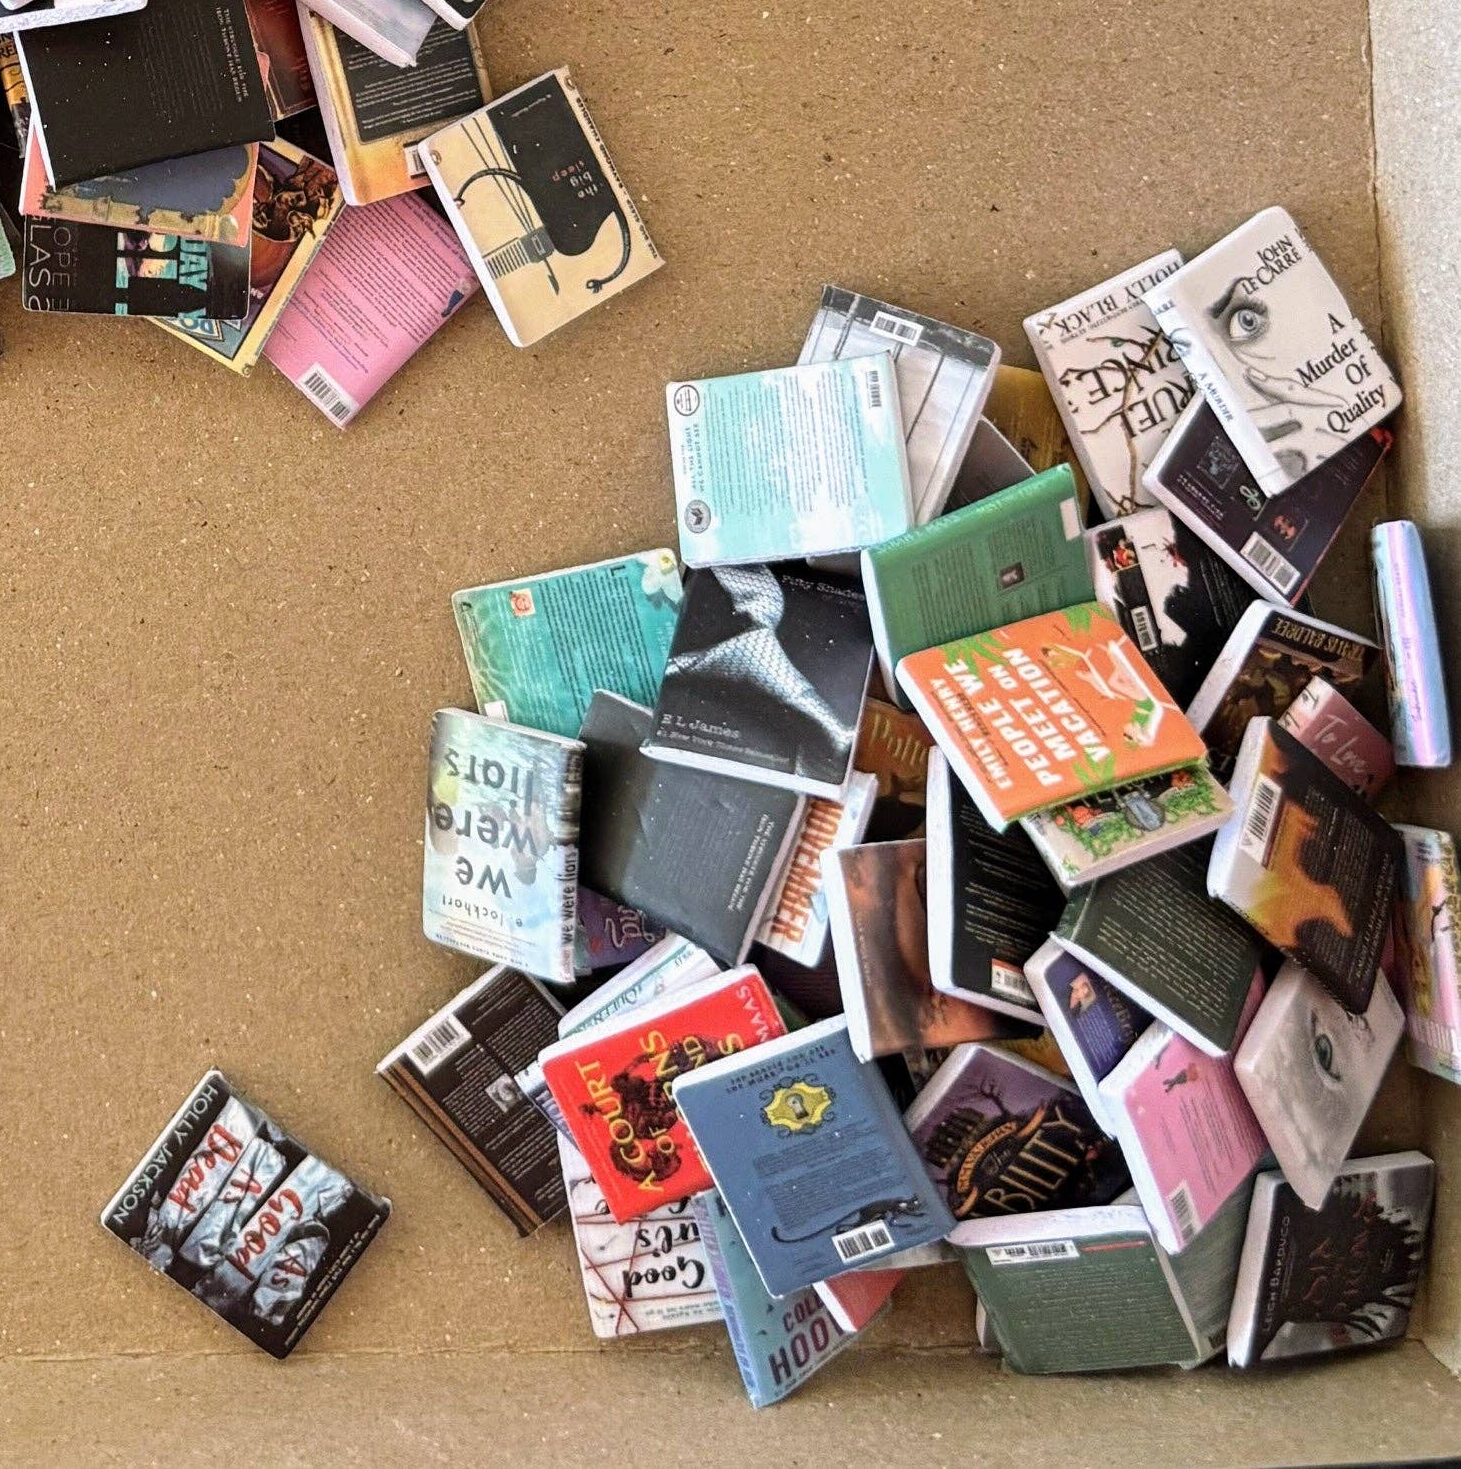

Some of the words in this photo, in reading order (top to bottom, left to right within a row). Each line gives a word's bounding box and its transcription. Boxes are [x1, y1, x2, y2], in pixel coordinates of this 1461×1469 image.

[1257, 235, 1293, 267] JOHN
[1242, 277, 1259, 295] LE
[1326, 312, 1345, 334] A
[1295, 337, 1360, 389] Murder
[1345, 356, 1374, 386] Of
[1326, 385, 1388, 434] Quality
[942, 658, 985, 697] WE
[988, 663, 1019, 691] ON
[930, 678, 976, 733] HENRY
[1002, 647, 1112, 763] VACATION
[977, 697, 1064, 787] PEOPLE
[1008, 696, 1078, 762] MEET
[446, 750, 533, 817] liars
[969, 737, 1014, 790] EMILY
[431, 800, 538, 858] were
[453, 855, 513, 899] we
[560, 847, 577, 887] liars
[561, 888, 576, 919] were
[561, 919, 574, 944] we
[174, 1084, 219, 1149] HOLLY
[576, 1058, 646, 1167] COURT
[650, 1123, 673, 1157] OF
[112, 1145, 175, 1225] JACKSON
[167, 1123, 244, 1213] Dead
[222, 1169, 263, 1206] As
[637, 1169, 666, 1192] A
[226, 1188, 304, 1283] Good
[621, 1254, 705, 1297] Good
